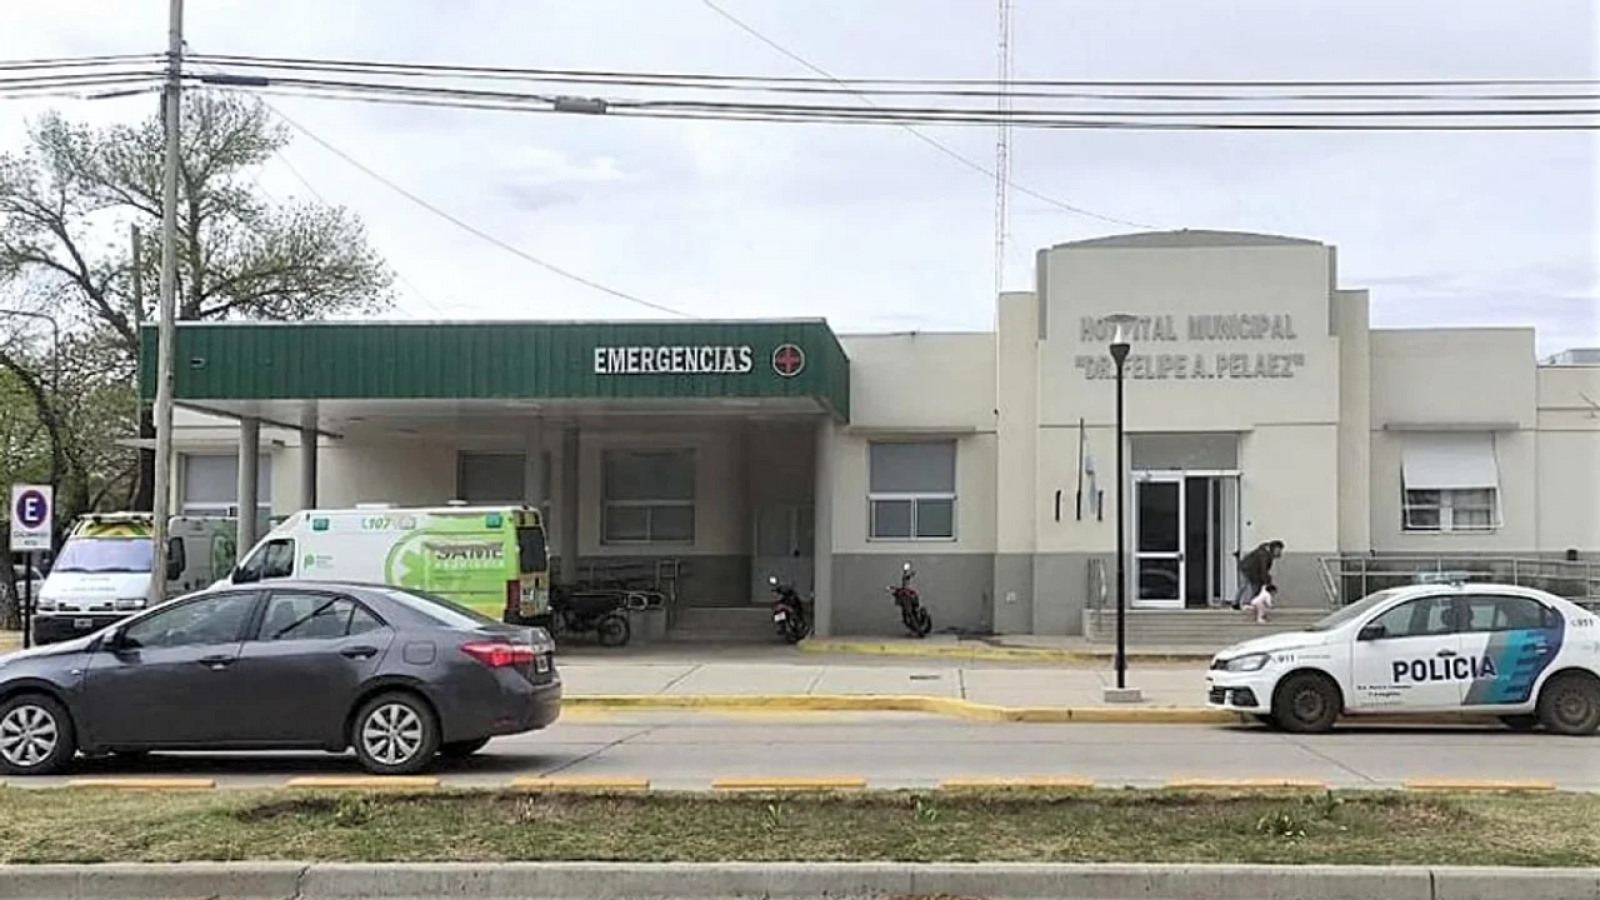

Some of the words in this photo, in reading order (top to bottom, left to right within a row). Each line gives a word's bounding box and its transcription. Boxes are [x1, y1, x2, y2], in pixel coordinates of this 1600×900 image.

[1188, 313, 1297, 340] MUNICIPAL
[594, 346, 752, 373] EMERGENCIAS
[1122, 354, 1187, 379] FELIPE
[25, 498, 39, 520] E
[1392, 656, 1496, 683] POLICIA
